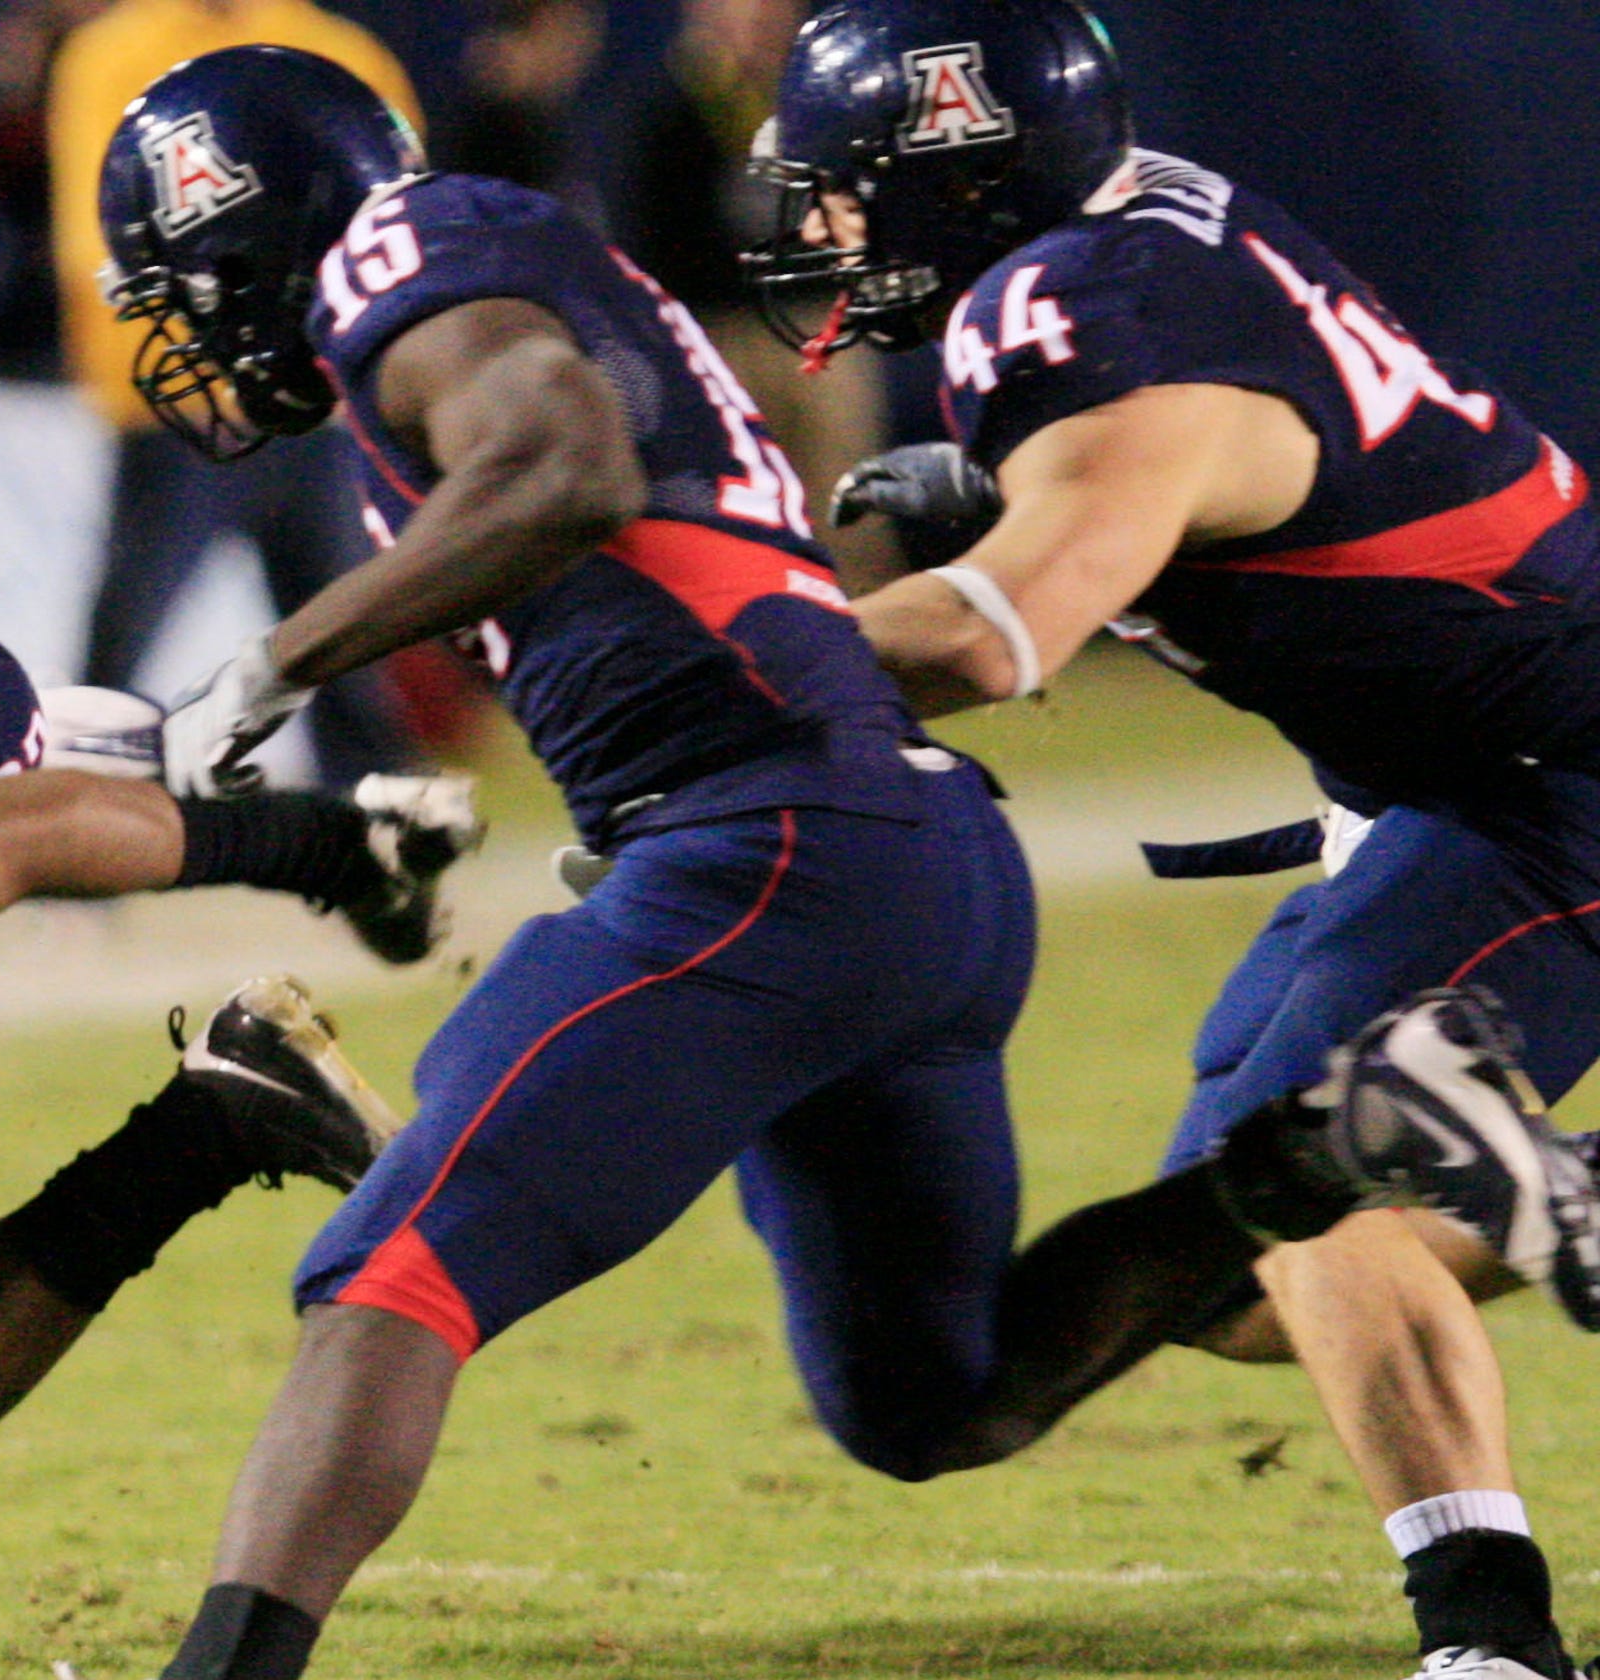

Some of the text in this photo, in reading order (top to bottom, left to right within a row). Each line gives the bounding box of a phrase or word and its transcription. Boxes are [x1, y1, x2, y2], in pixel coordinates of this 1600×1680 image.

[898, 41, 1016, 154] A
[139, 110, 264, 239] A
[315, 195, 426, 336] 15
[943, 263, 1078, 395] 44
